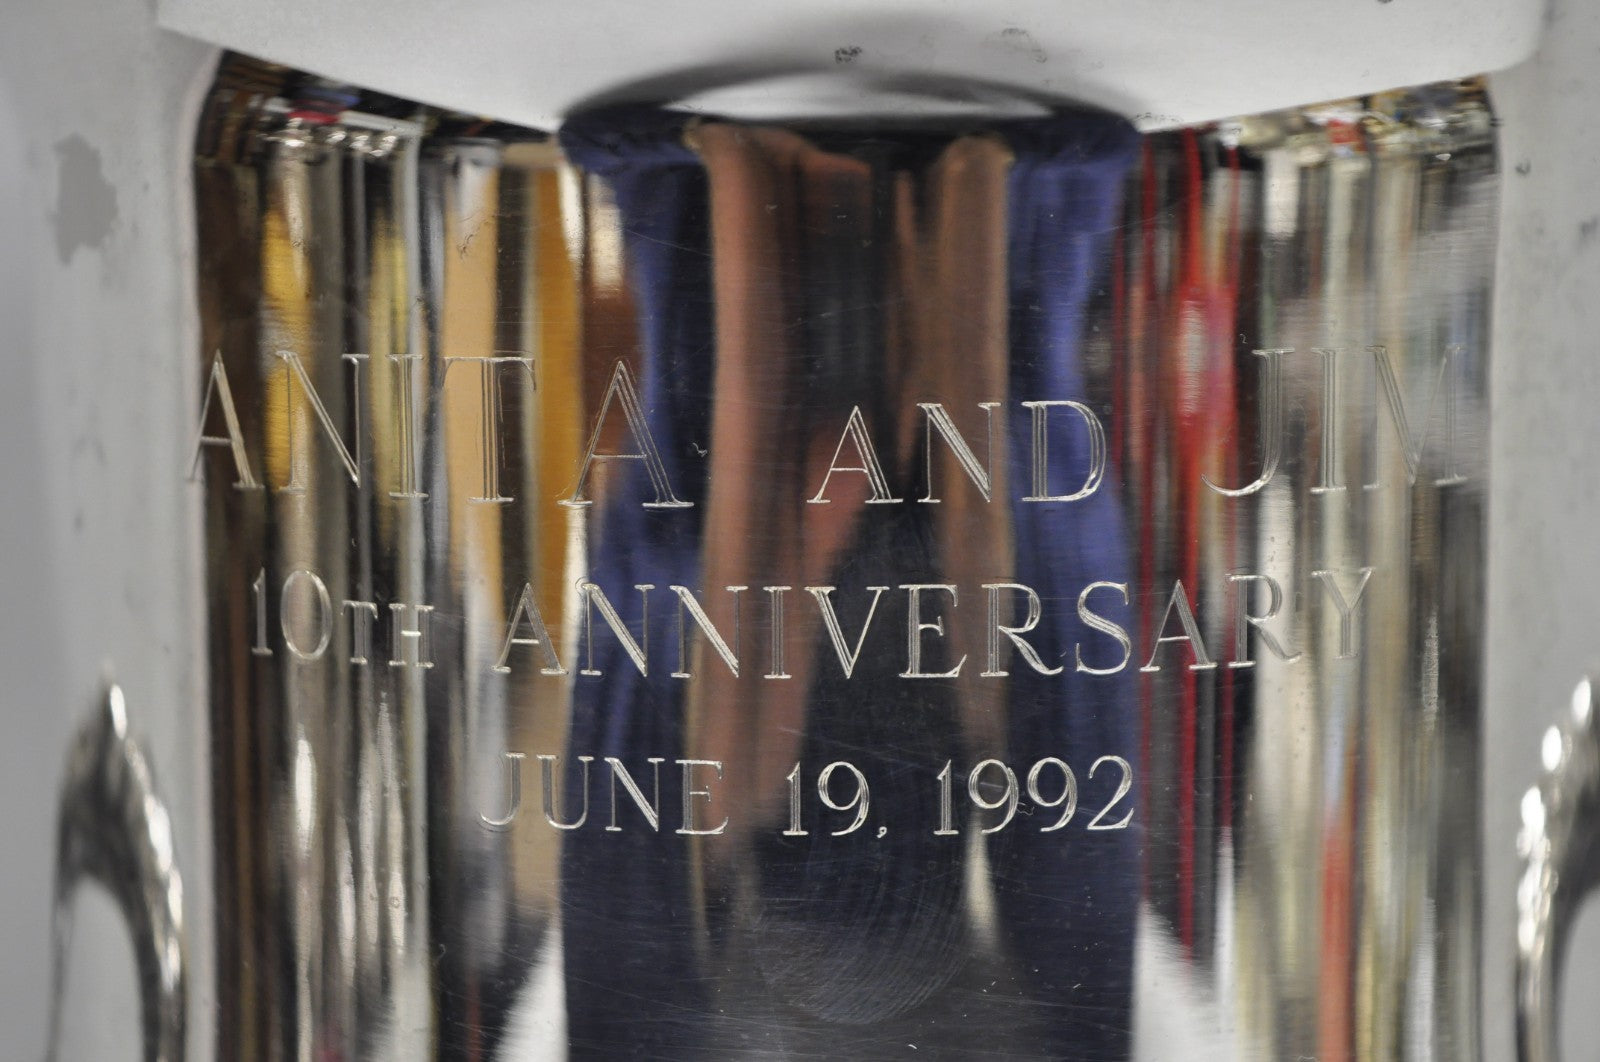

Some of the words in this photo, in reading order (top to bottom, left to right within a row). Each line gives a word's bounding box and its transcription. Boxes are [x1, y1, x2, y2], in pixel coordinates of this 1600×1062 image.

[186, 348, 695, 508] ANITA
[806, 400, 1106, 504] AND
[1200, 344, 1469, 498] JIM
[251, 566, 434, 669] 10TH
[491, 567, 1376, 680] ANNIVERSARY
[478, 752, 729, 837] JUNE
[782, 761, 888, 840] 19,
[933, 755, 1135, 837] 1992
